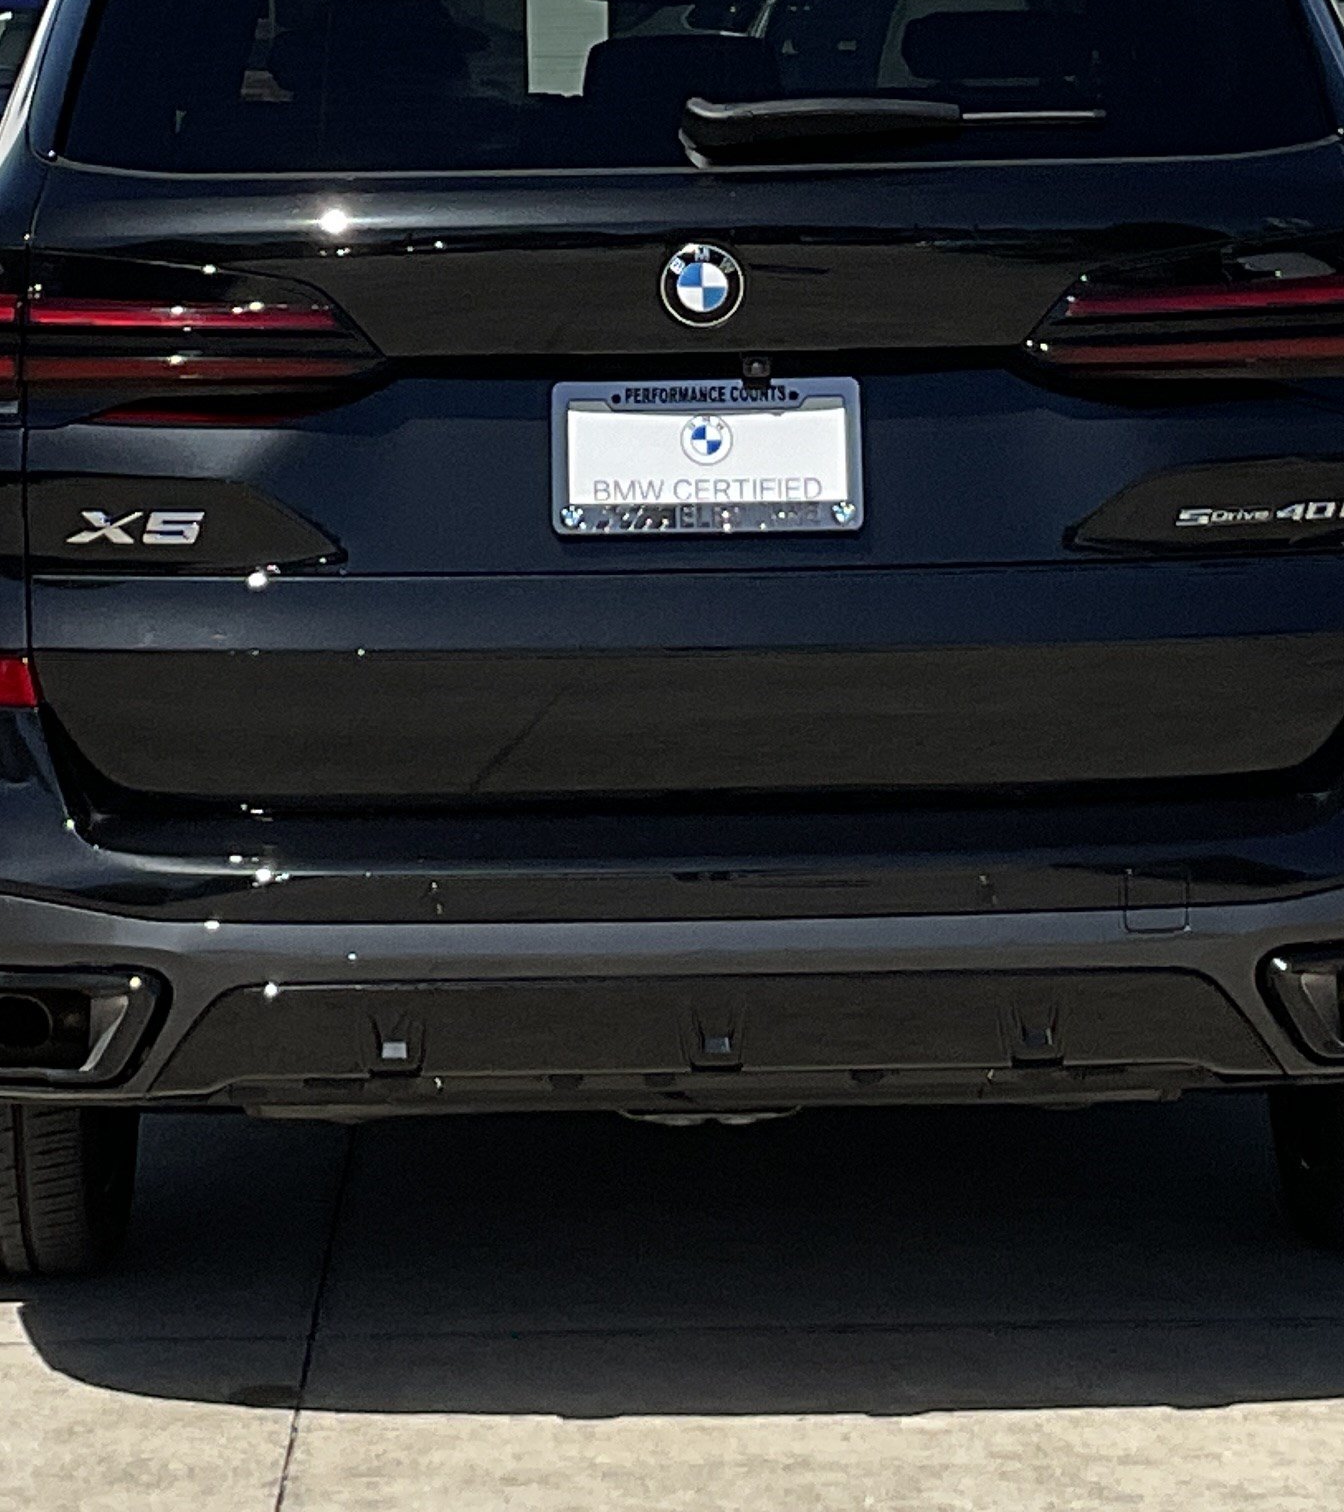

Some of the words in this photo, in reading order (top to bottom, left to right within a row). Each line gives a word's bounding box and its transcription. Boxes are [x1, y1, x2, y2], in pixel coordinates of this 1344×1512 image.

[625, 386, 726, 405] PERFORMANCE
[730, 385, 786, 403] COUNTS
[593, 479, 665, 502] BMW
[672, 477, 823, 501] CERTIFIED
[66, 511, 205, 545] X5
